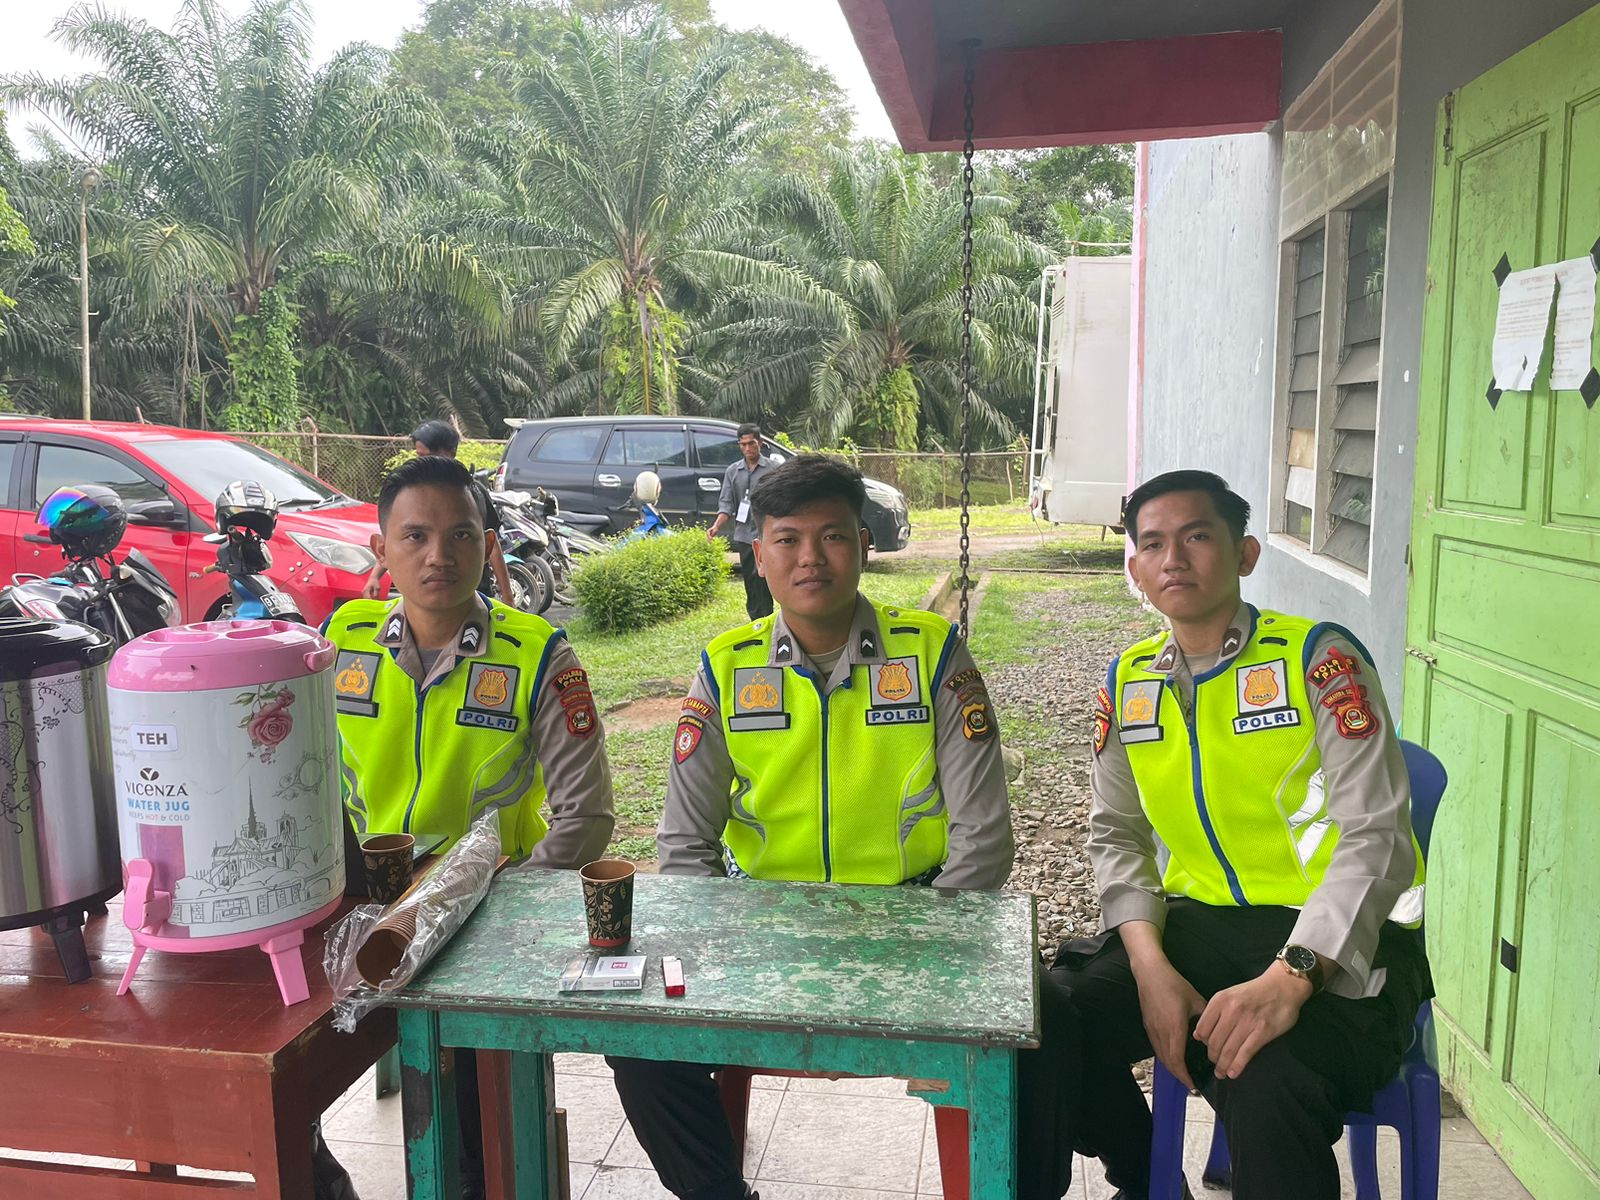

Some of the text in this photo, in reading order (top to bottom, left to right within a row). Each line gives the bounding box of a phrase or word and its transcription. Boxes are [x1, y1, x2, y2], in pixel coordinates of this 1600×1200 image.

[463, 712, 513, 728] POLRI
[871, 709, 923, 721] POLRI
[1239, 712, 1293, 730] POLRI
[136, 732, 168, 745] TEH
[127, 798, 190, 811] WATER JUG
